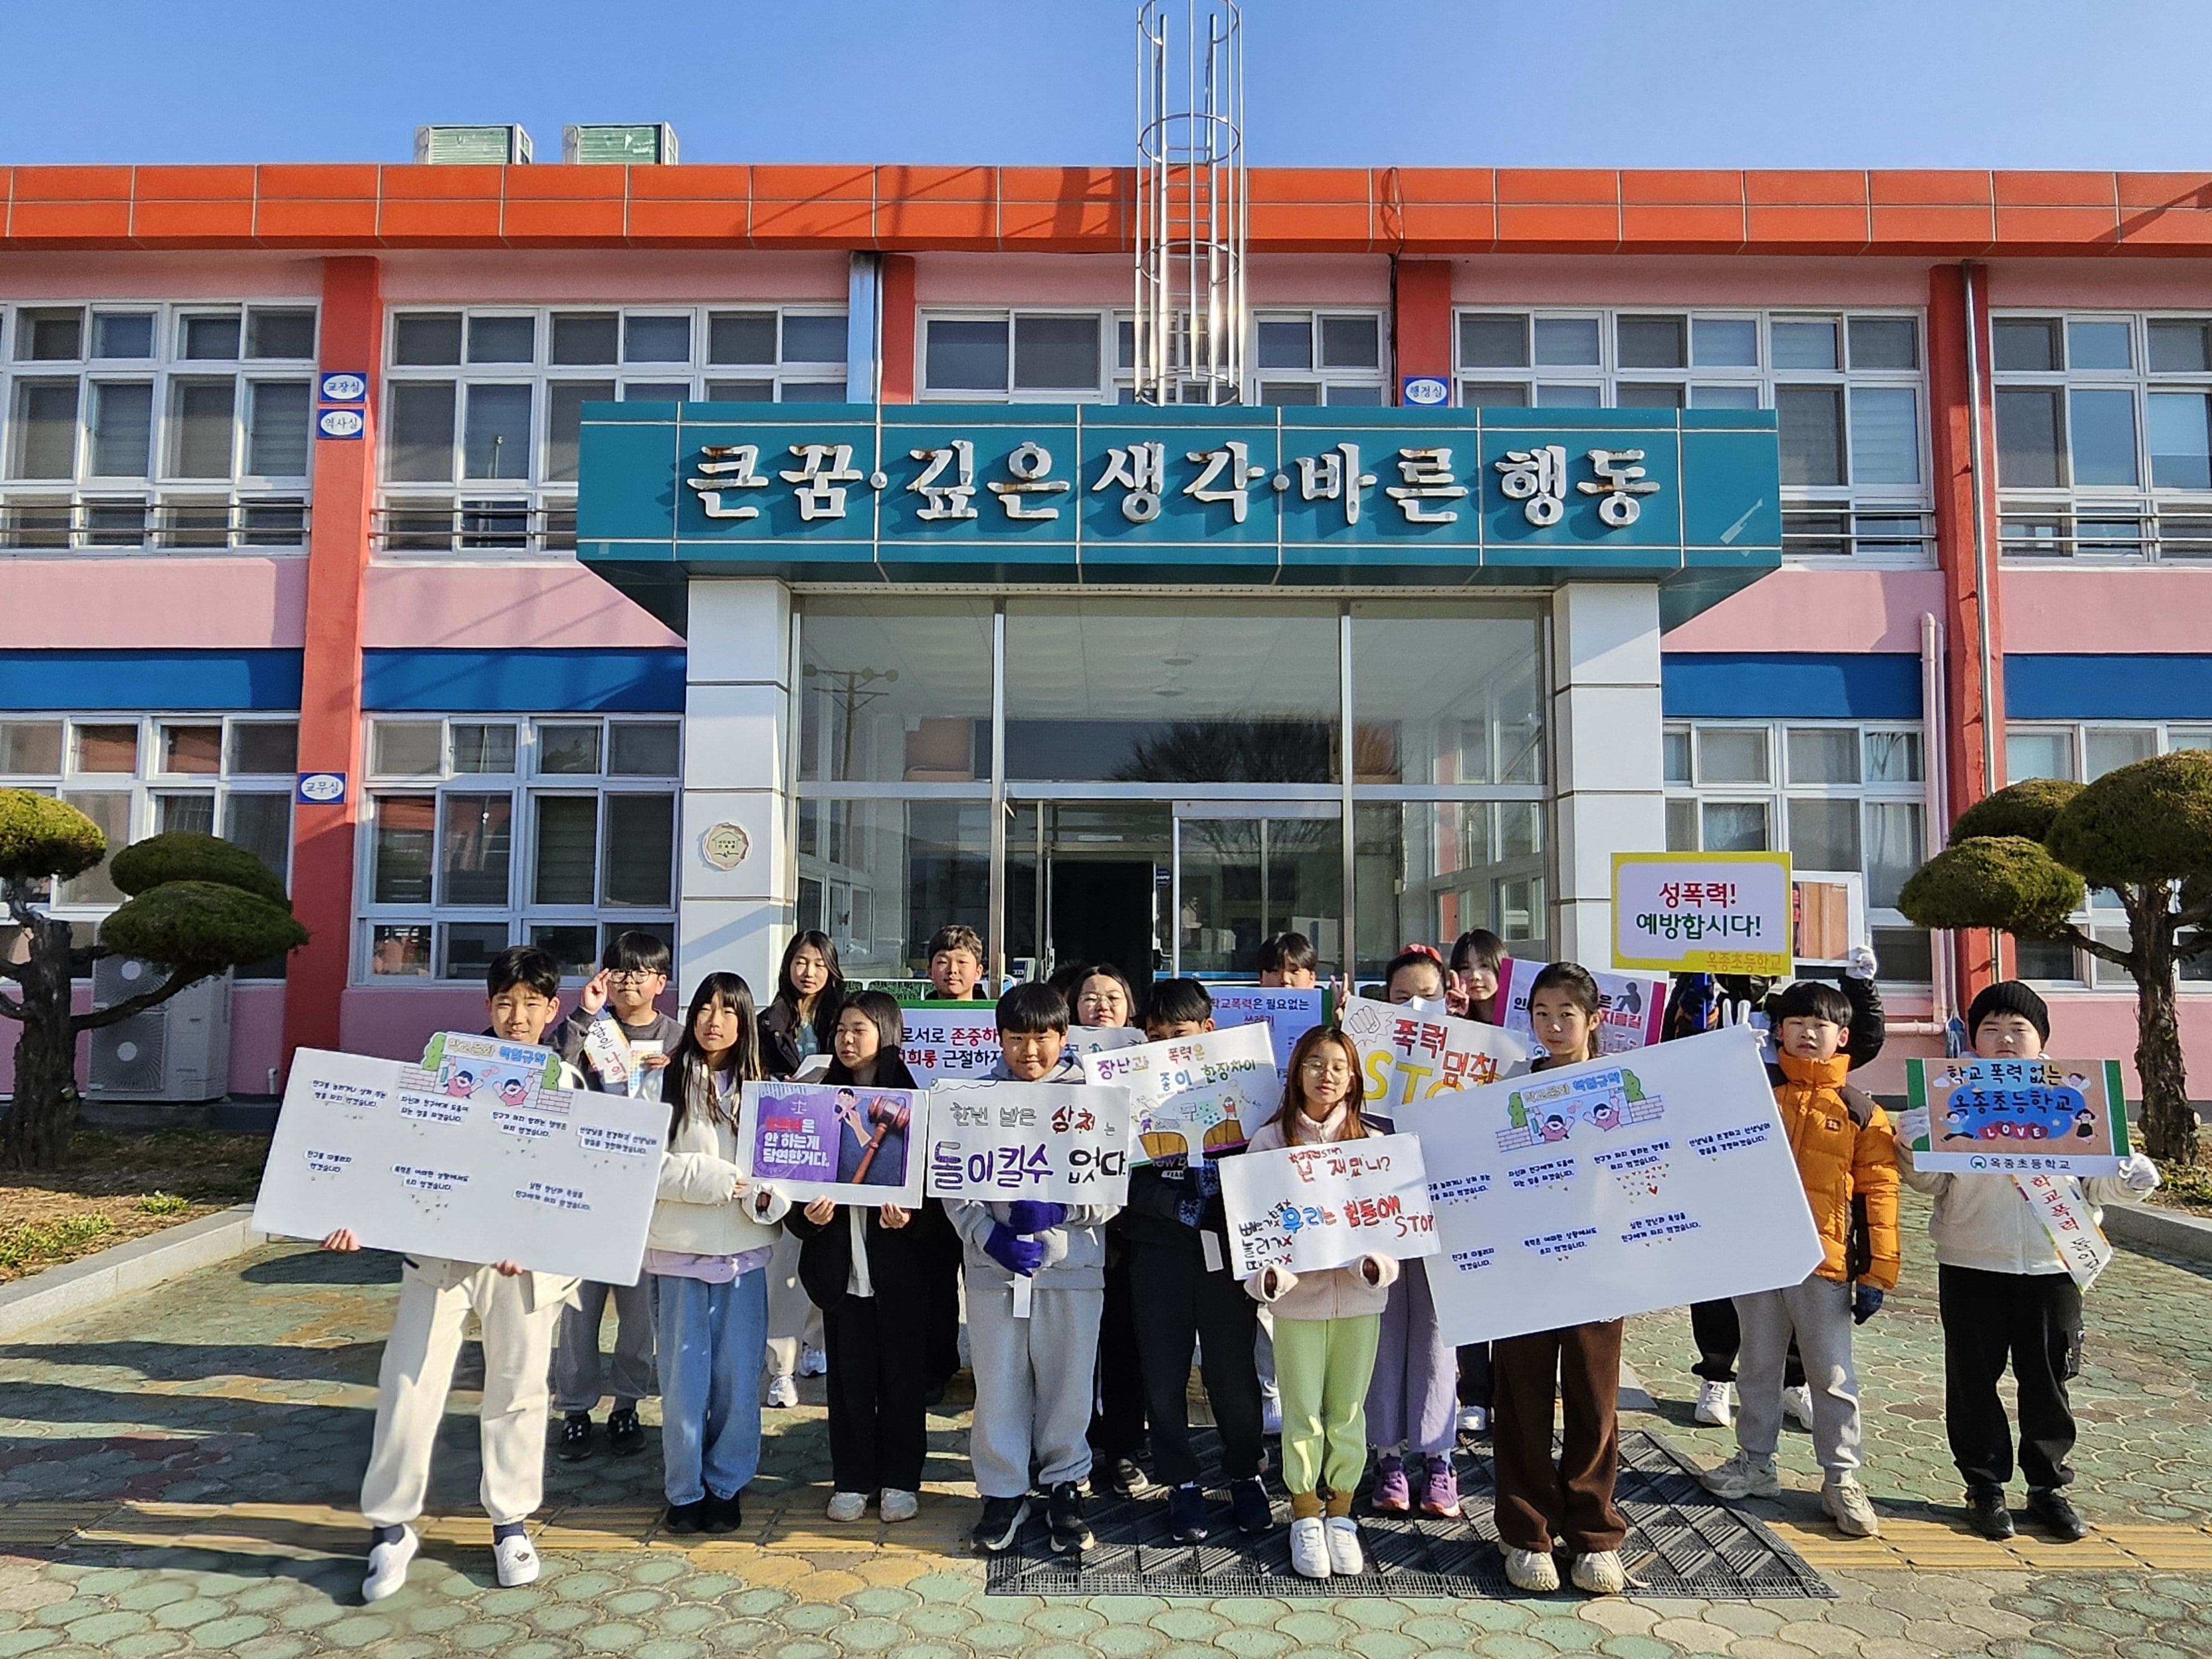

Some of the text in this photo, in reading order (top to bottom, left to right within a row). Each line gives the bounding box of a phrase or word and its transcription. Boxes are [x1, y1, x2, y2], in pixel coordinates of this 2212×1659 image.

[327, 380, 359, 393] 교장실
[1410, 385, 1442, 398] 행정실
[687, 444, 769, 520] 큰
[906, 440, 1071, 521] 깊은
[1295, 442, 1469, 525] 바른
[1494, 445, 1661, 528] 행동
[305, 781, 338, 794] 교무실
[1658, 882, 1736, 909] 성폭력!
[1636, 913, 1761, 940] 예방합시다!
[1706, 952, 1782, 972] 옥종초등학교
[1266, 998, 1310, 1011] 필요없는
[1392, 1019, 1448, 1059] 폭력
[1097, 1044, 1204, 1080] 장난과 폭력은
[1947, 1063, 2063, 1085] 학교 폭력 없는
[1160, 1070, 1193, 1092] 종이
[1201, 1059, 1256, 1083] 한장차이
[950, 1102, 989, 1127] 한번
[1953, 1090, 2074, 1115] 옥종초등학교
[764, 1131, 820, 1150] 안 하는게
[1986, 1125, 2041, 1138] LOVE
[931, 1141, 1053, 1190] 돌이킬수
[1990, 1157, 2070, 1170] 옥종초등학교
[1282, 1203, 1337, 1234] 우리는
[1394, 1214, 1434, 1238] STOP
